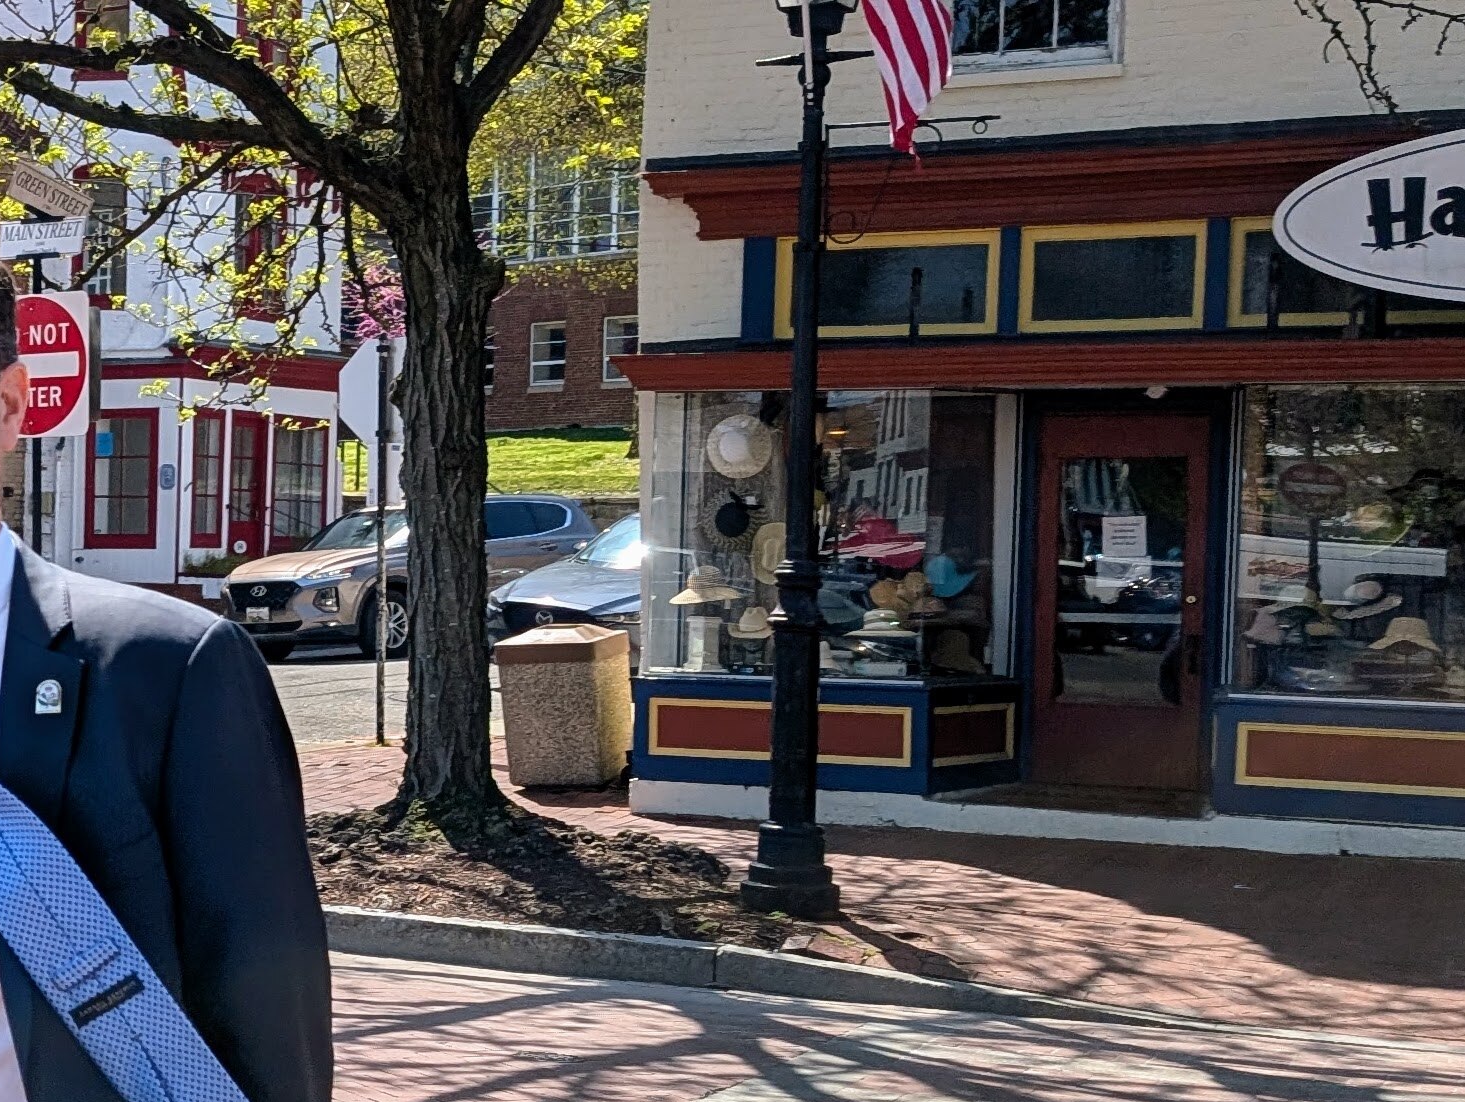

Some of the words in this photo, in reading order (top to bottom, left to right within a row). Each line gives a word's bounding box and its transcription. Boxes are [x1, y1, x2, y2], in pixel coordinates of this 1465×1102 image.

[16, 171, 51, 199] GREEN
[48, 188, 88, 216] STREET
[1361, 177, 1465, 251] Ha
[2, 226, 37, 242] MAIN
[35, 221, 82, 239] STREET
[29, 322, 70, 346] NOT
[28, 386, 62, 408] TER
